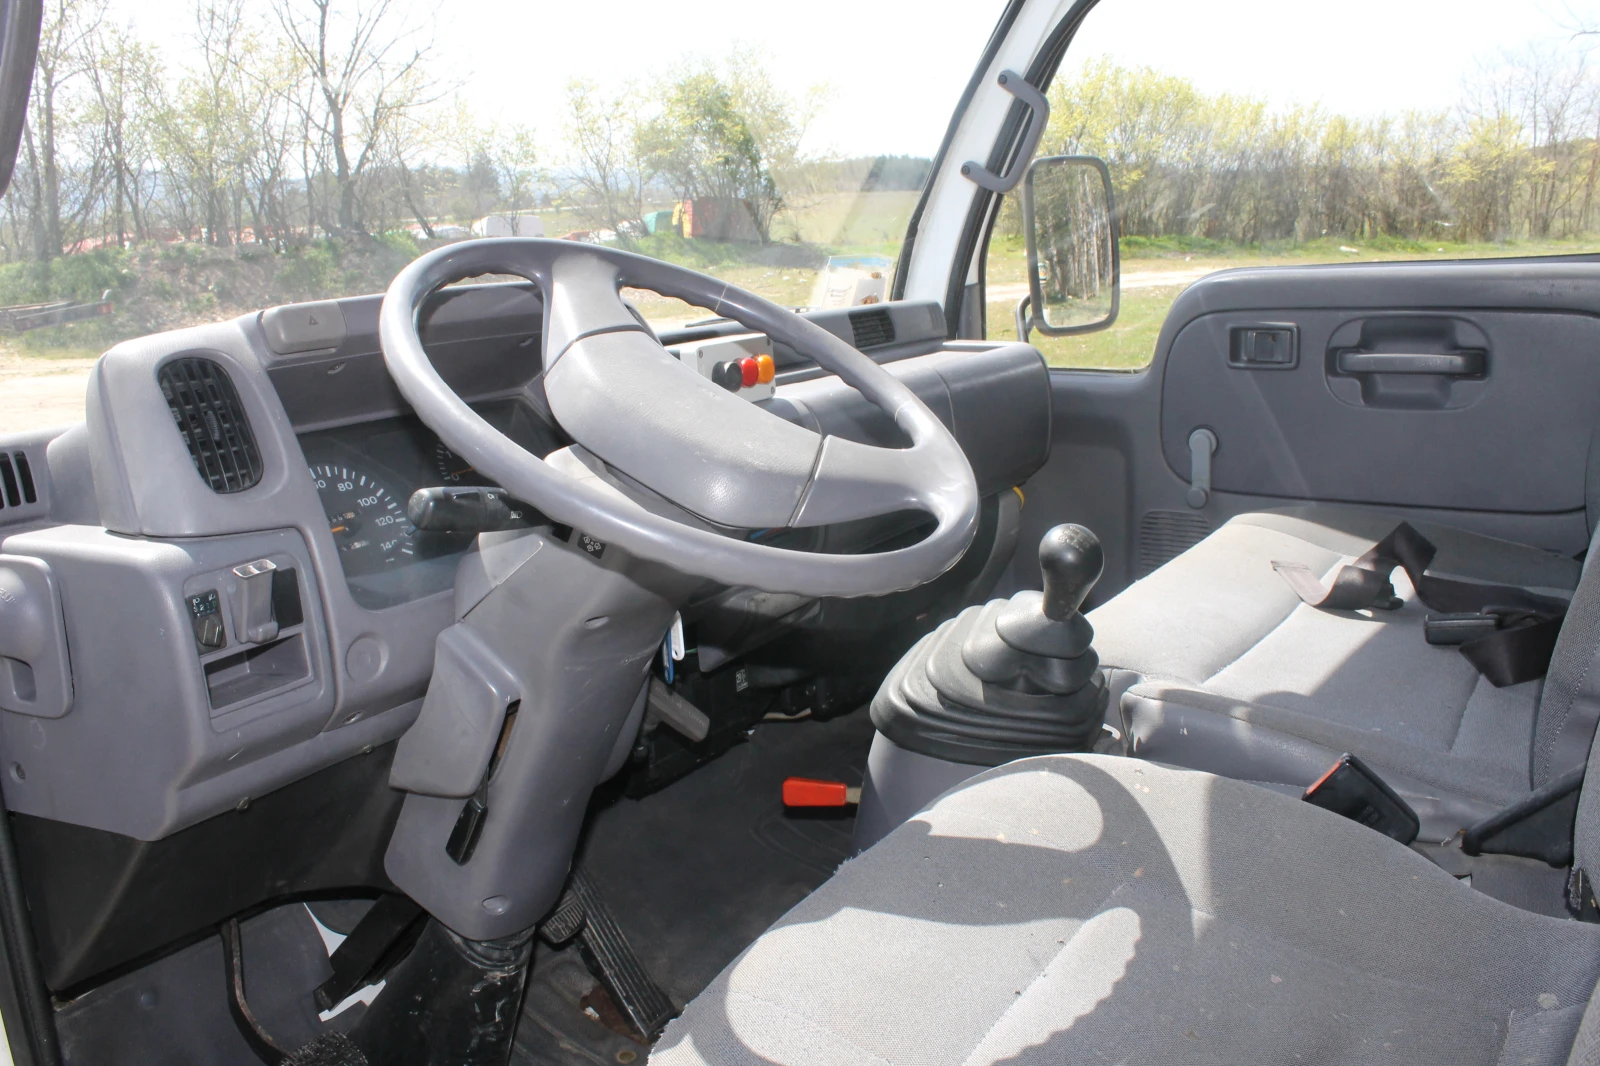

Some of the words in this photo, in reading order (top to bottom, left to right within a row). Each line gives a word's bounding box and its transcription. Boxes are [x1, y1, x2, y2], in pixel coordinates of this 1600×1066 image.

[337, 481, 354, 492] 80
[357, 495, 378, 507] 100
[375, 515, 394, 527] 120
